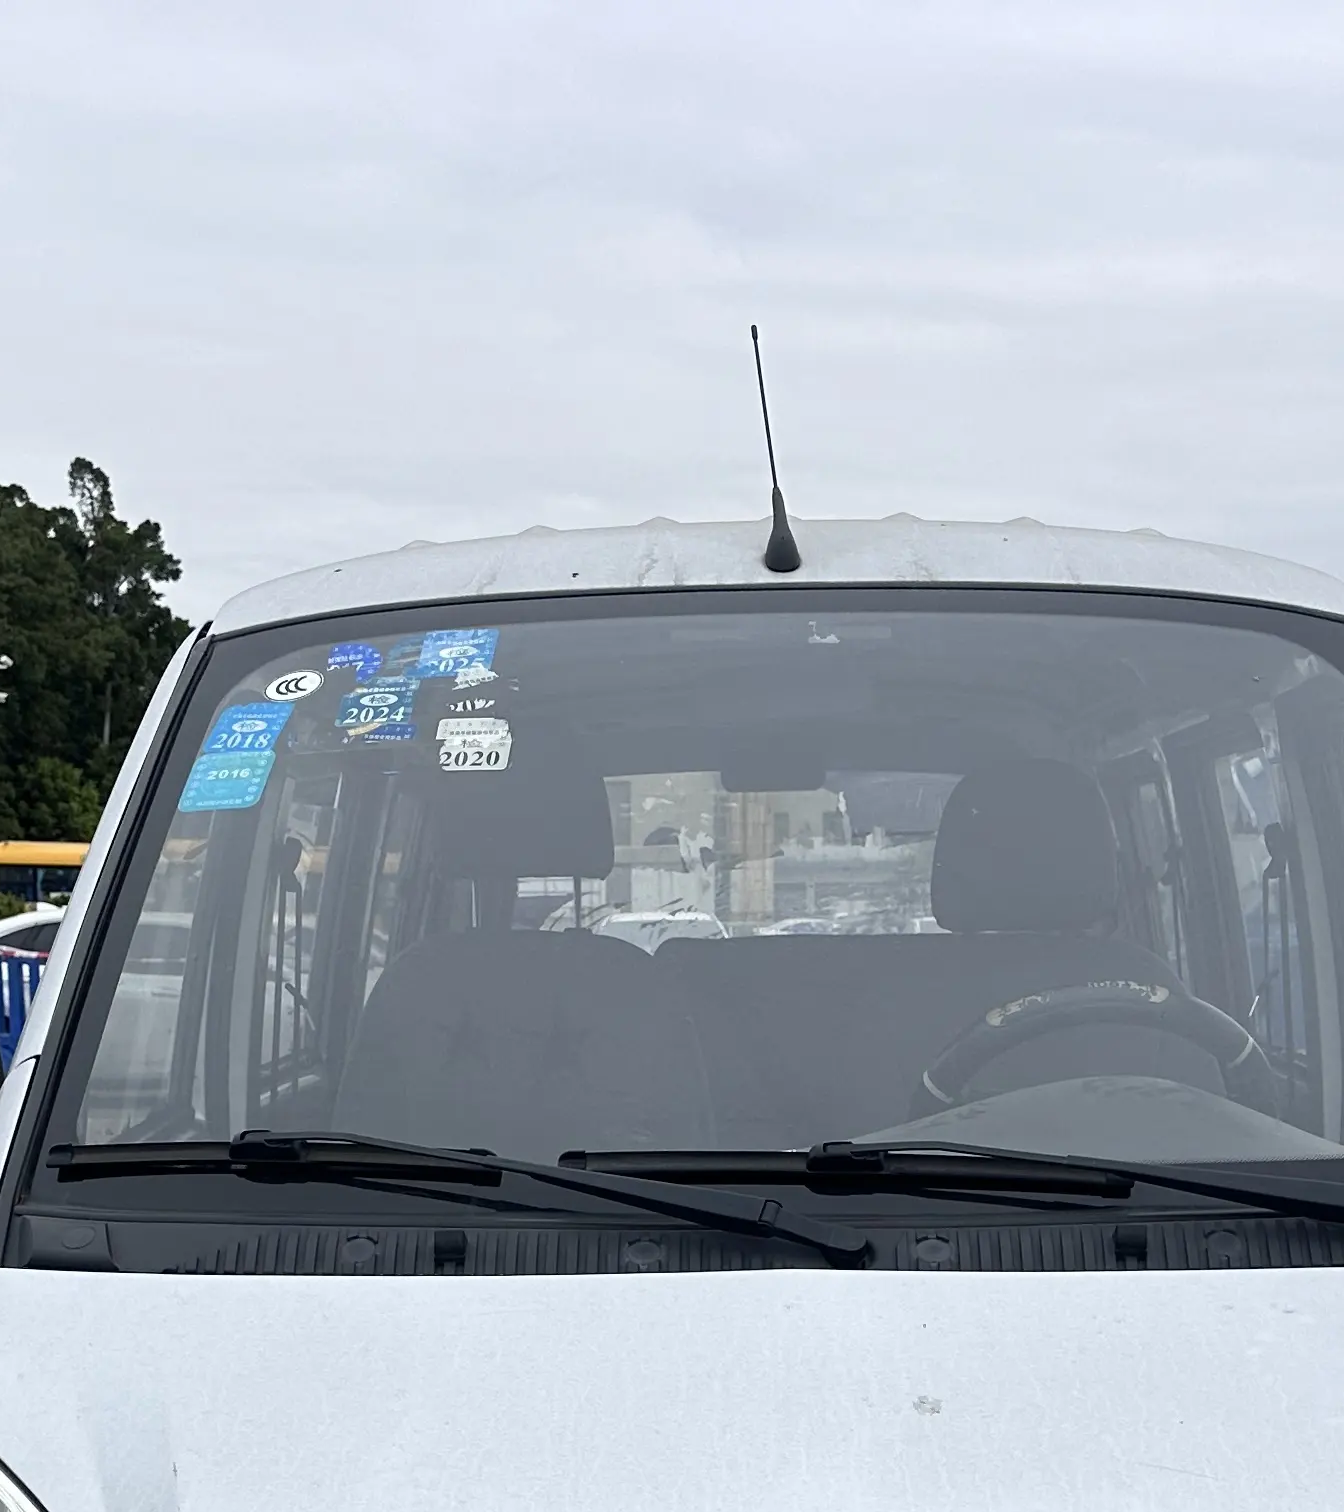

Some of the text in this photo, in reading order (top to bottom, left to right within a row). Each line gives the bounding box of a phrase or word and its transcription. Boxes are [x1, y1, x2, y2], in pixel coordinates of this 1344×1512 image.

[275, 675, 308, 696] CCC
[342, 705, 405, 724] 2024
[211, 732, 272, 749] 2018
[439, 750, 500, 767] 2020
[207, 767, 251, 781] 2016
